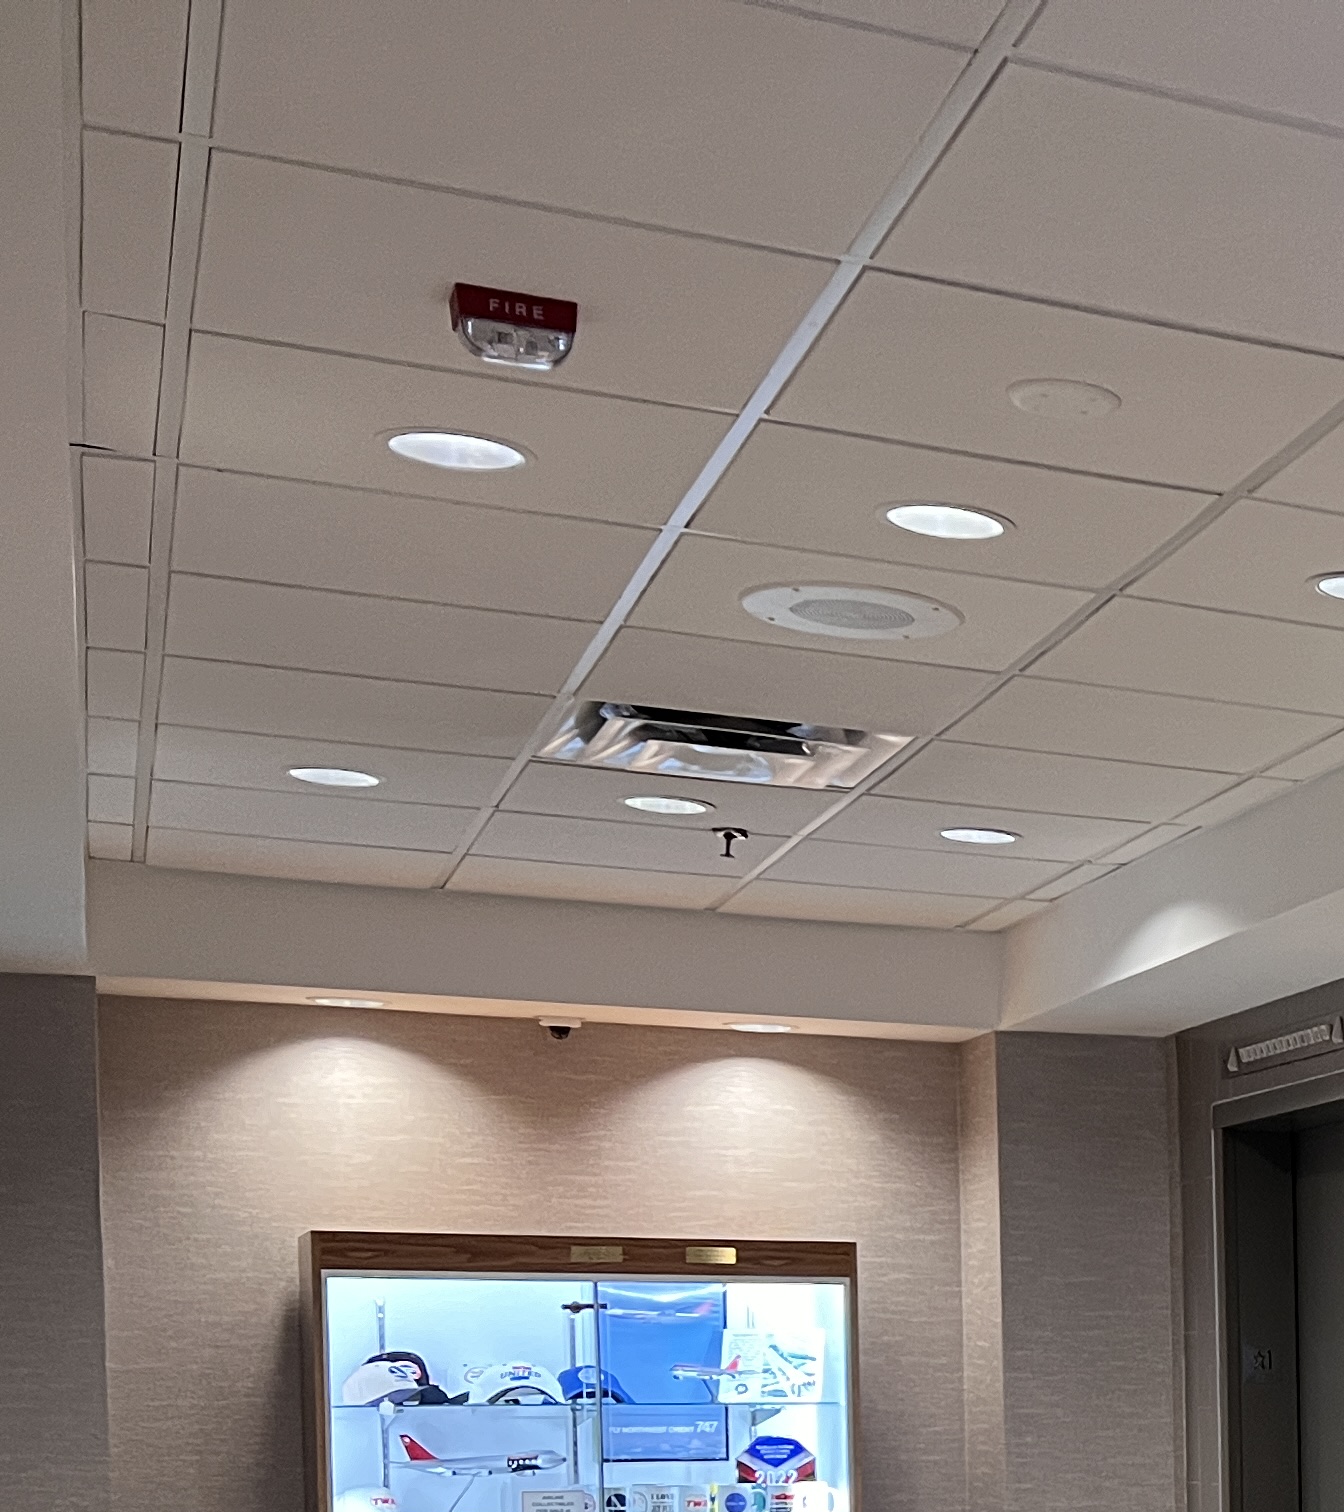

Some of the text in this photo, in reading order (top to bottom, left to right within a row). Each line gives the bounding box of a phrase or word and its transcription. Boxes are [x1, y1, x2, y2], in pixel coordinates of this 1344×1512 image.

[488, 298, 545, 320] FIRE
[695, 1420, 719, 1433] 747
[754, 1469, 798, 1484] 2022
